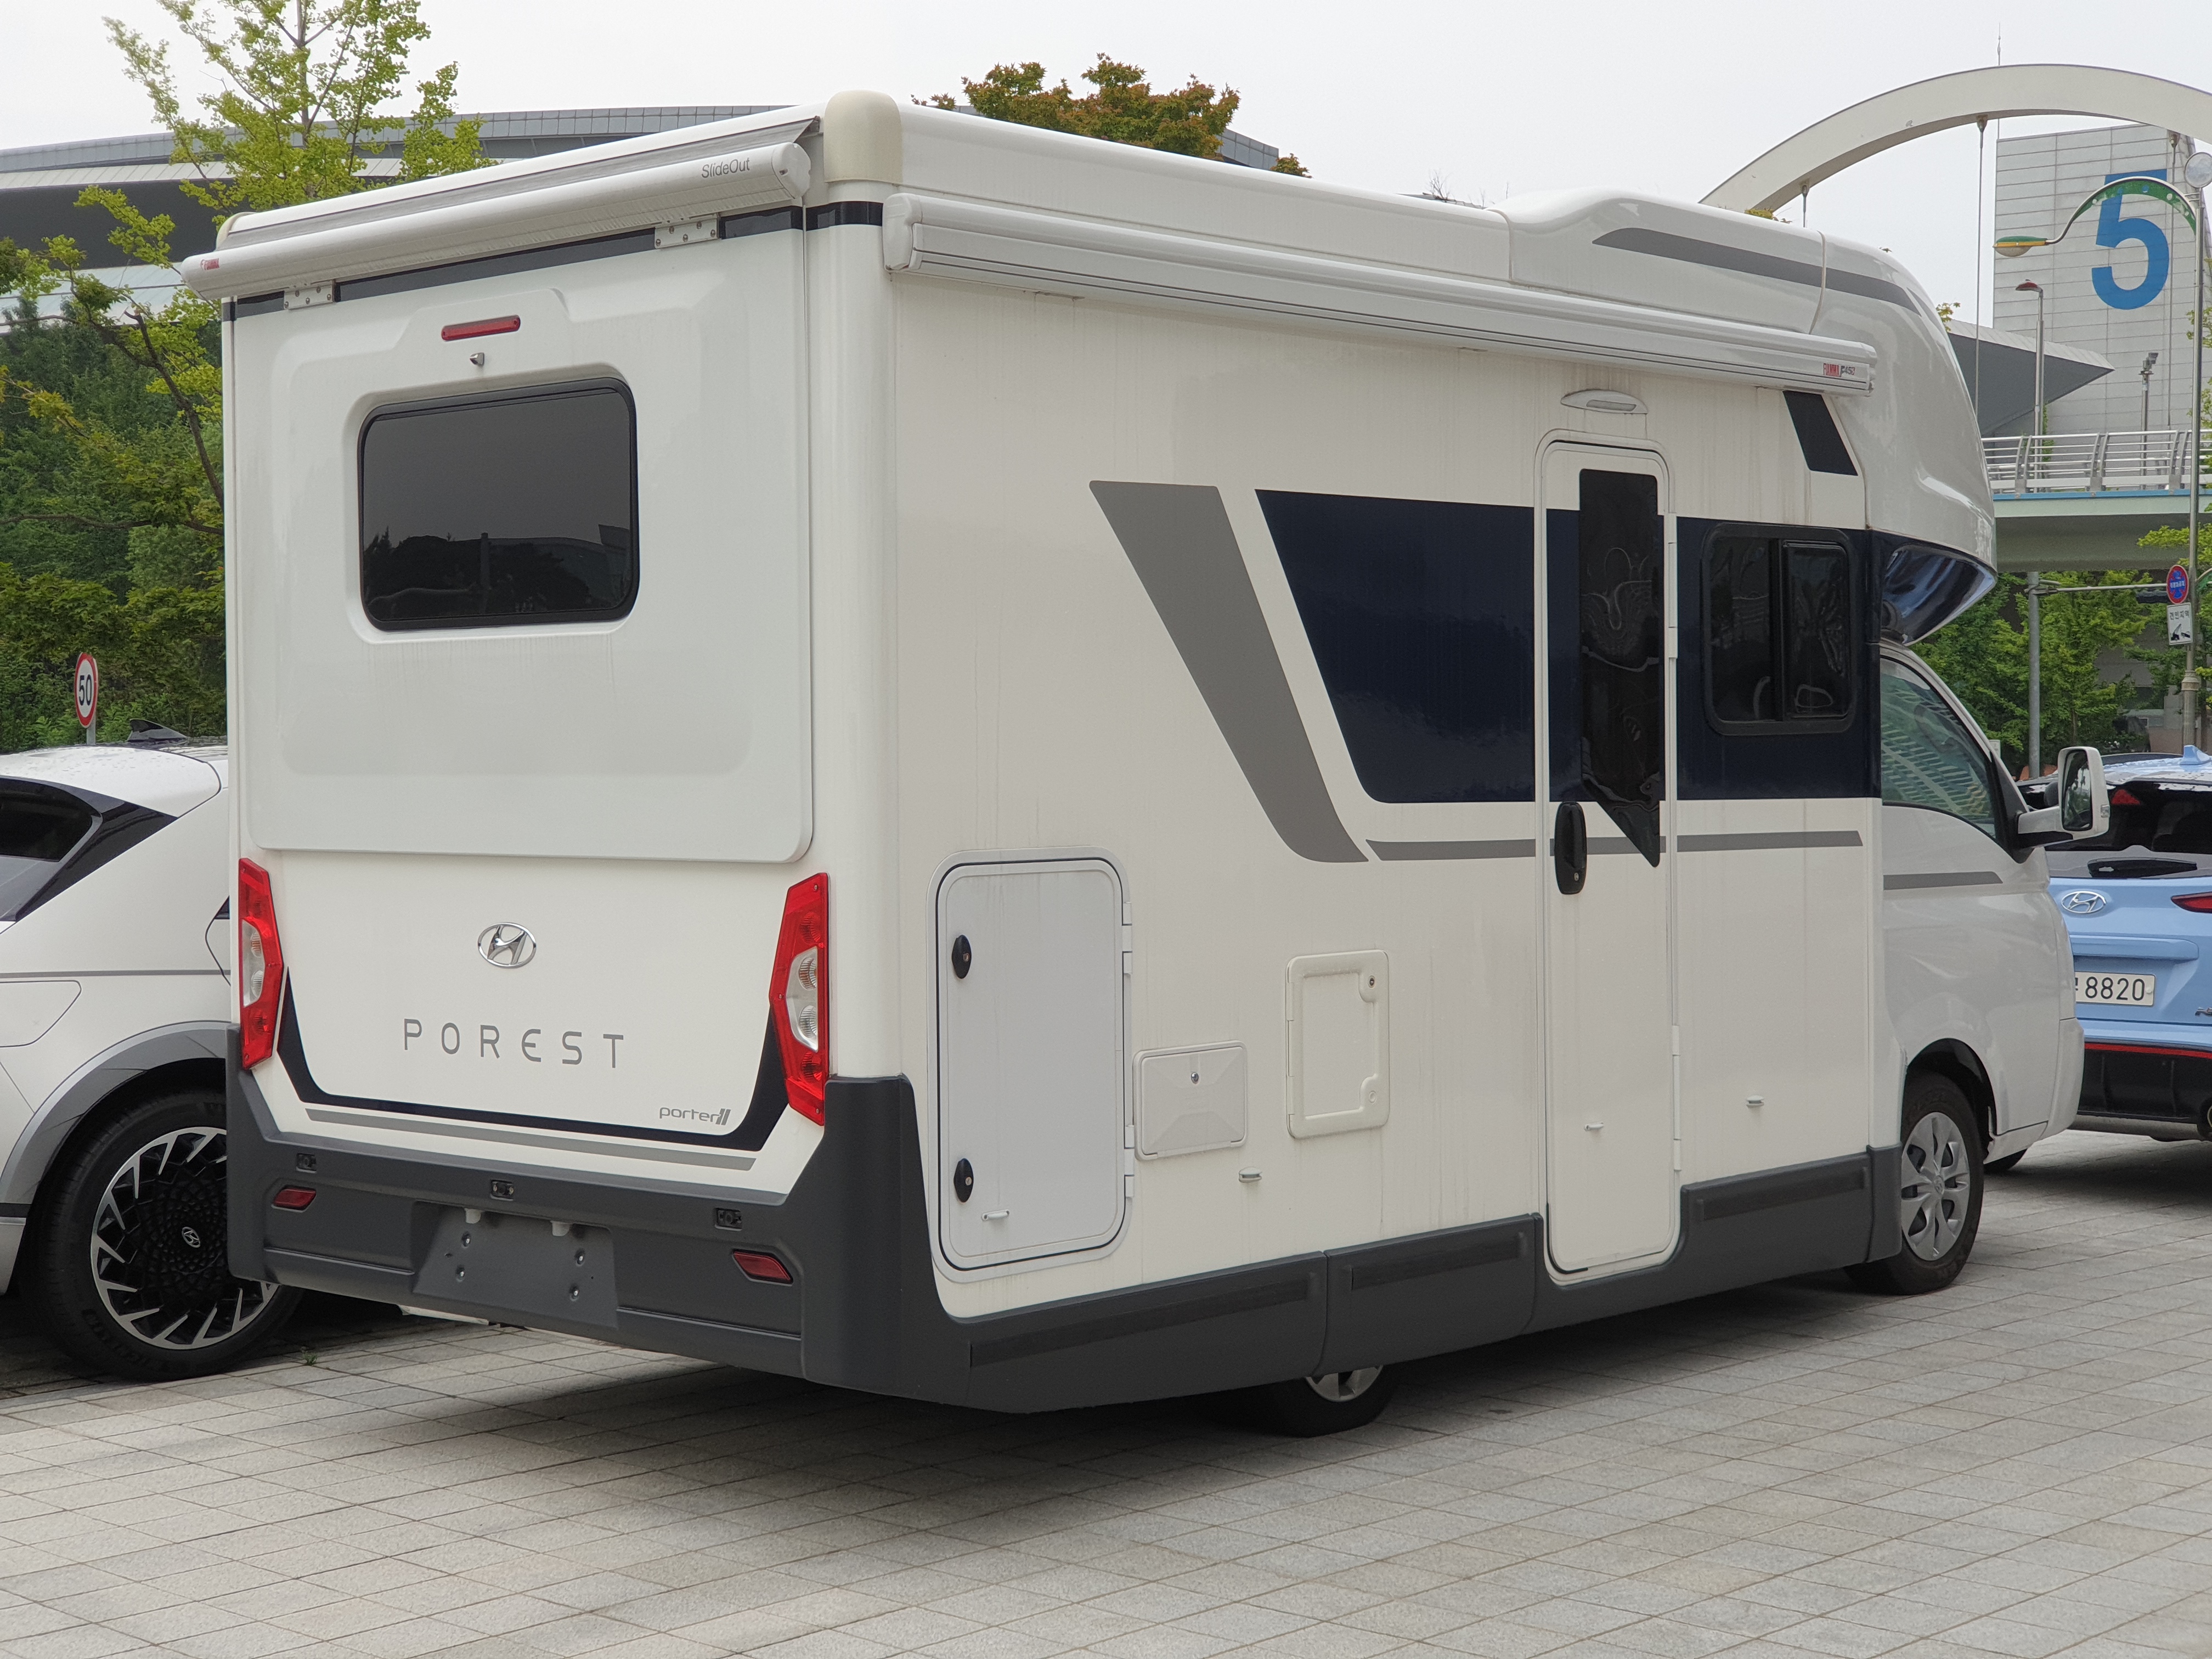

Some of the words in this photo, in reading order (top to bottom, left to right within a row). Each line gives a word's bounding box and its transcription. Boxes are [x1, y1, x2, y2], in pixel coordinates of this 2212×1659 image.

[702, 157, 750, 178] SlideOut
[2091, 168, 2170, 310] 5
[78, 674, 92, 706] 50
[2085, 976, 2145, 1001] 8820
[404, 1018, 624, 1069] POREST
